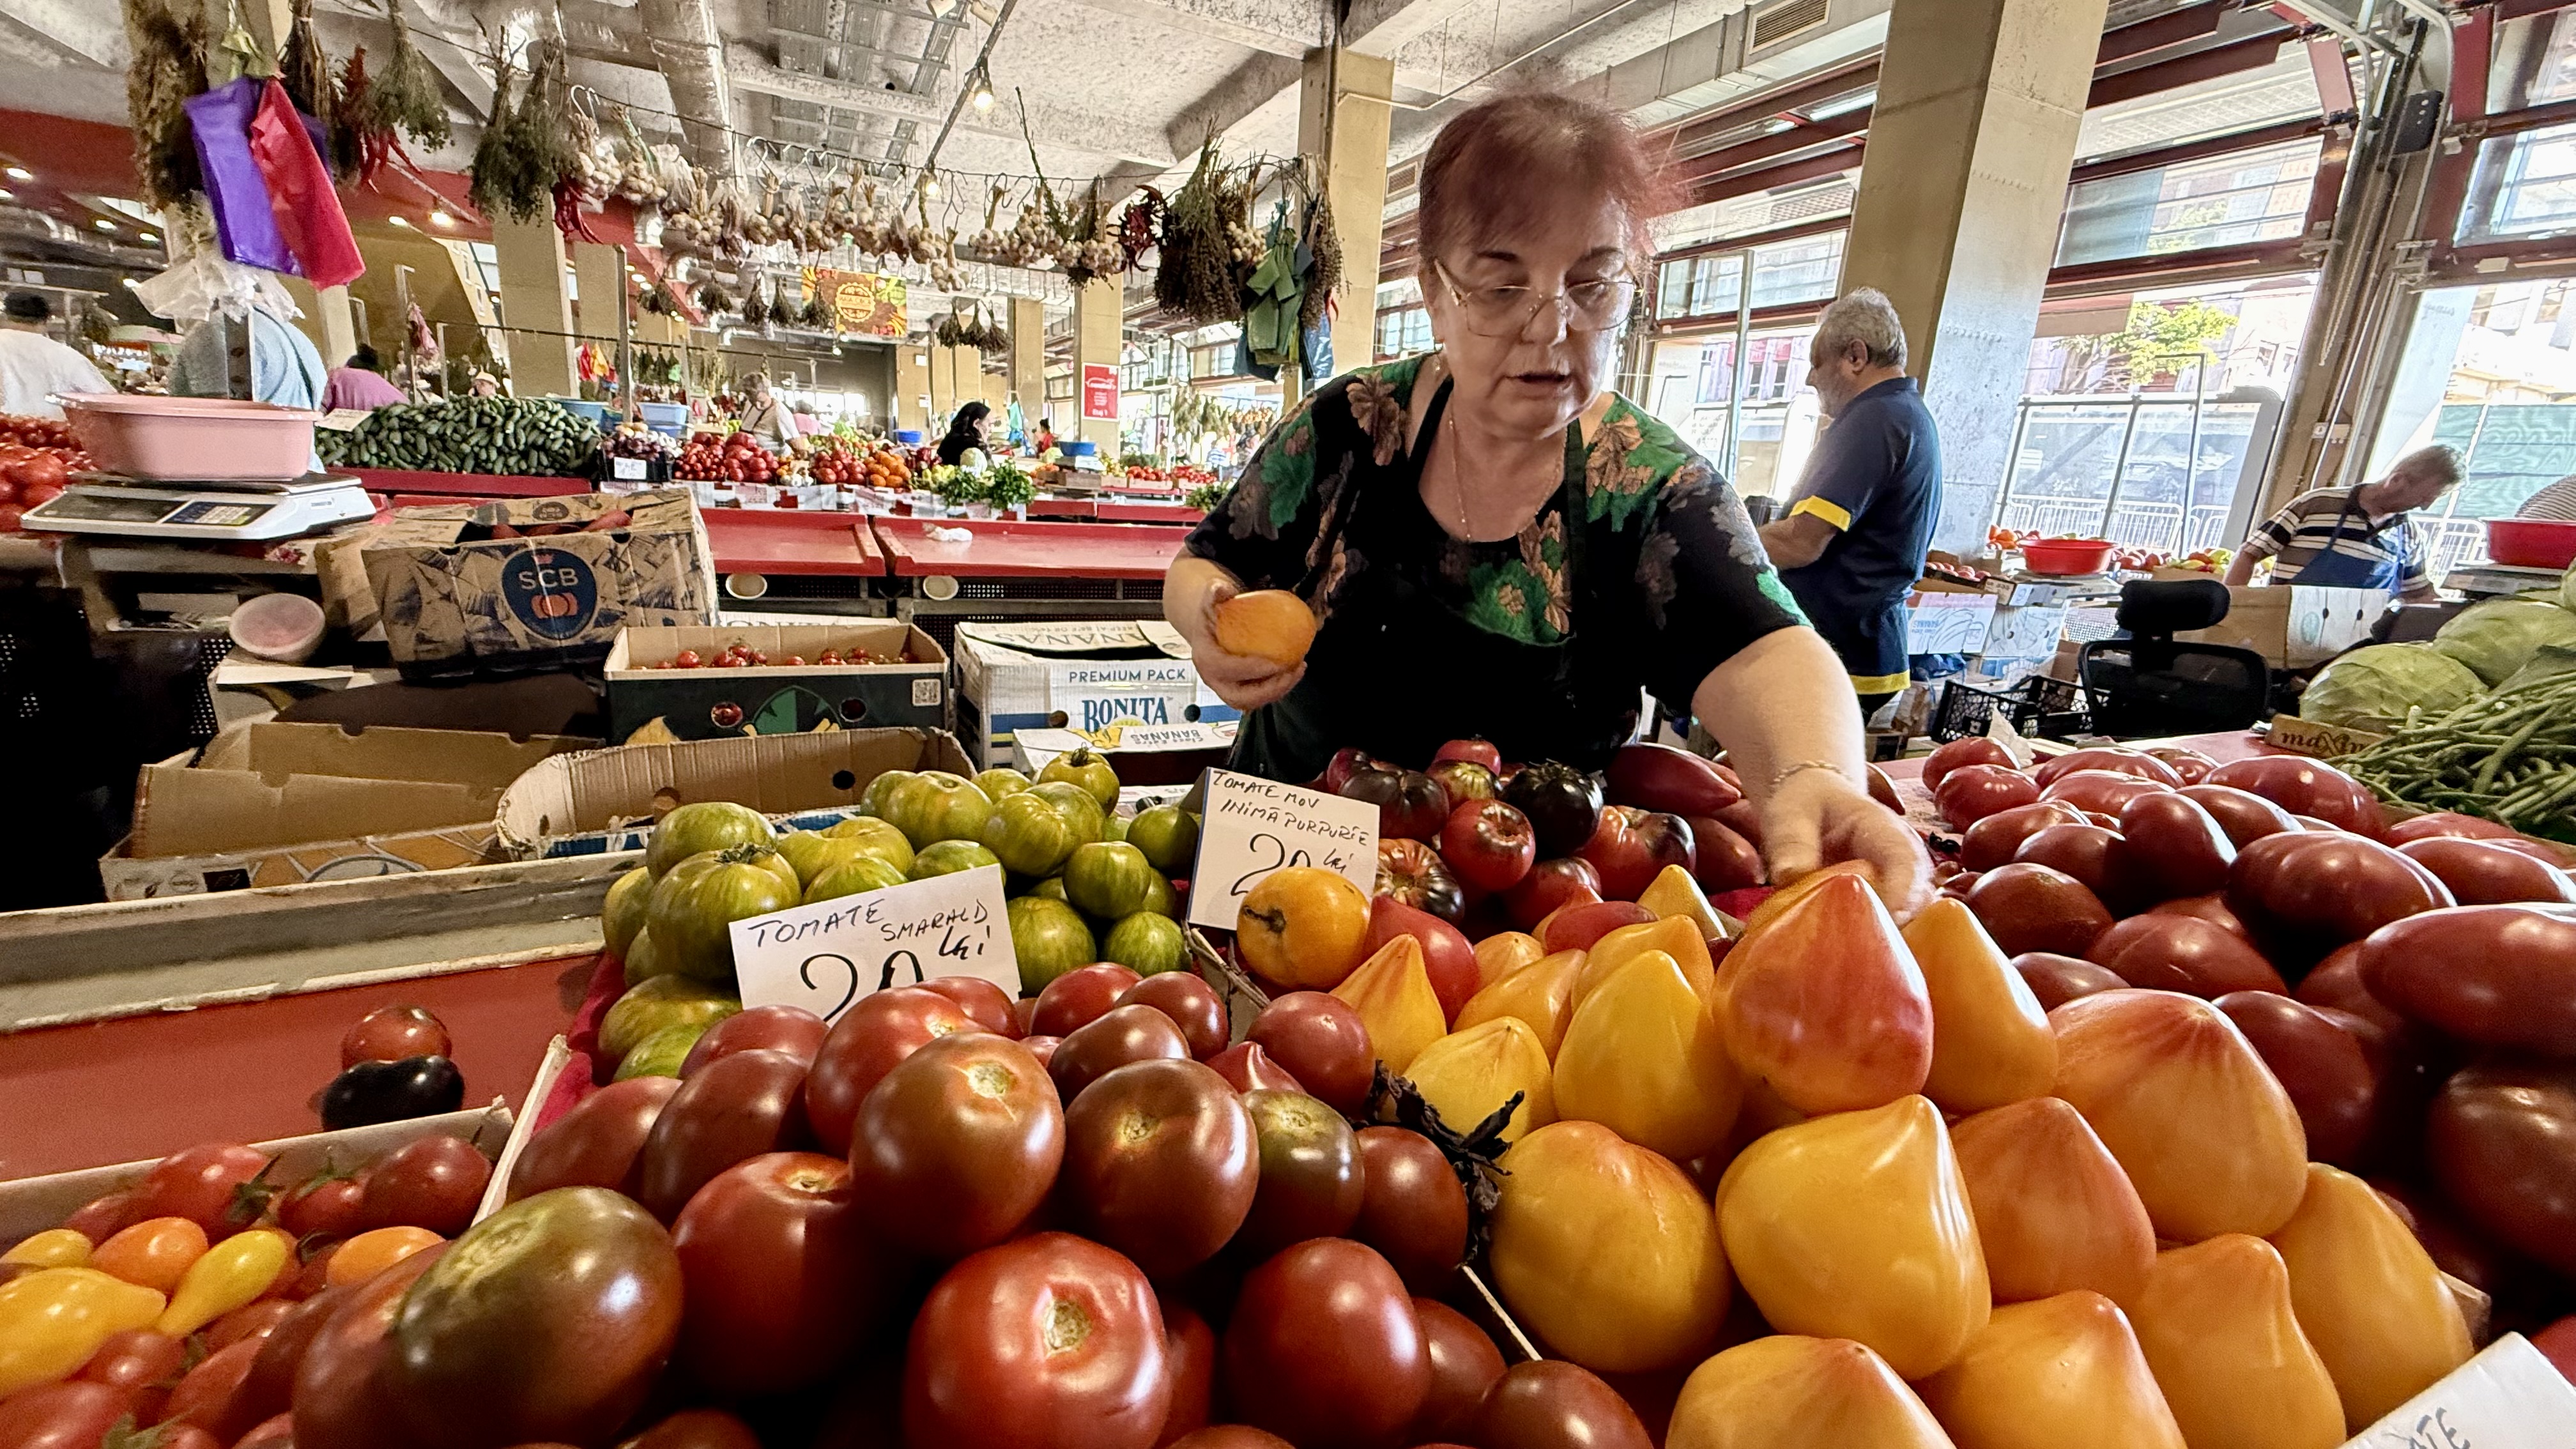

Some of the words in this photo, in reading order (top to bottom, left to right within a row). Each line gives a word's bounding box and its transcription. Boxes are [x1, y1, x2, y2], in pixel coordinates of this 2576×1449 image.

[519, 567, 578, 590] SCB
[1070, 670, 1141, 682] PREMIUM
[1147, 668, 1186, 680] PACK
[1082, 697, 1169, 733] BONITA
[1131, 730, 1201, 740] BANANAS
[1213, 770, 1280, 798] TOMATE
[1284, 792, 1320, 809] MOV
[747, 898, 885, 947] TOMATE
